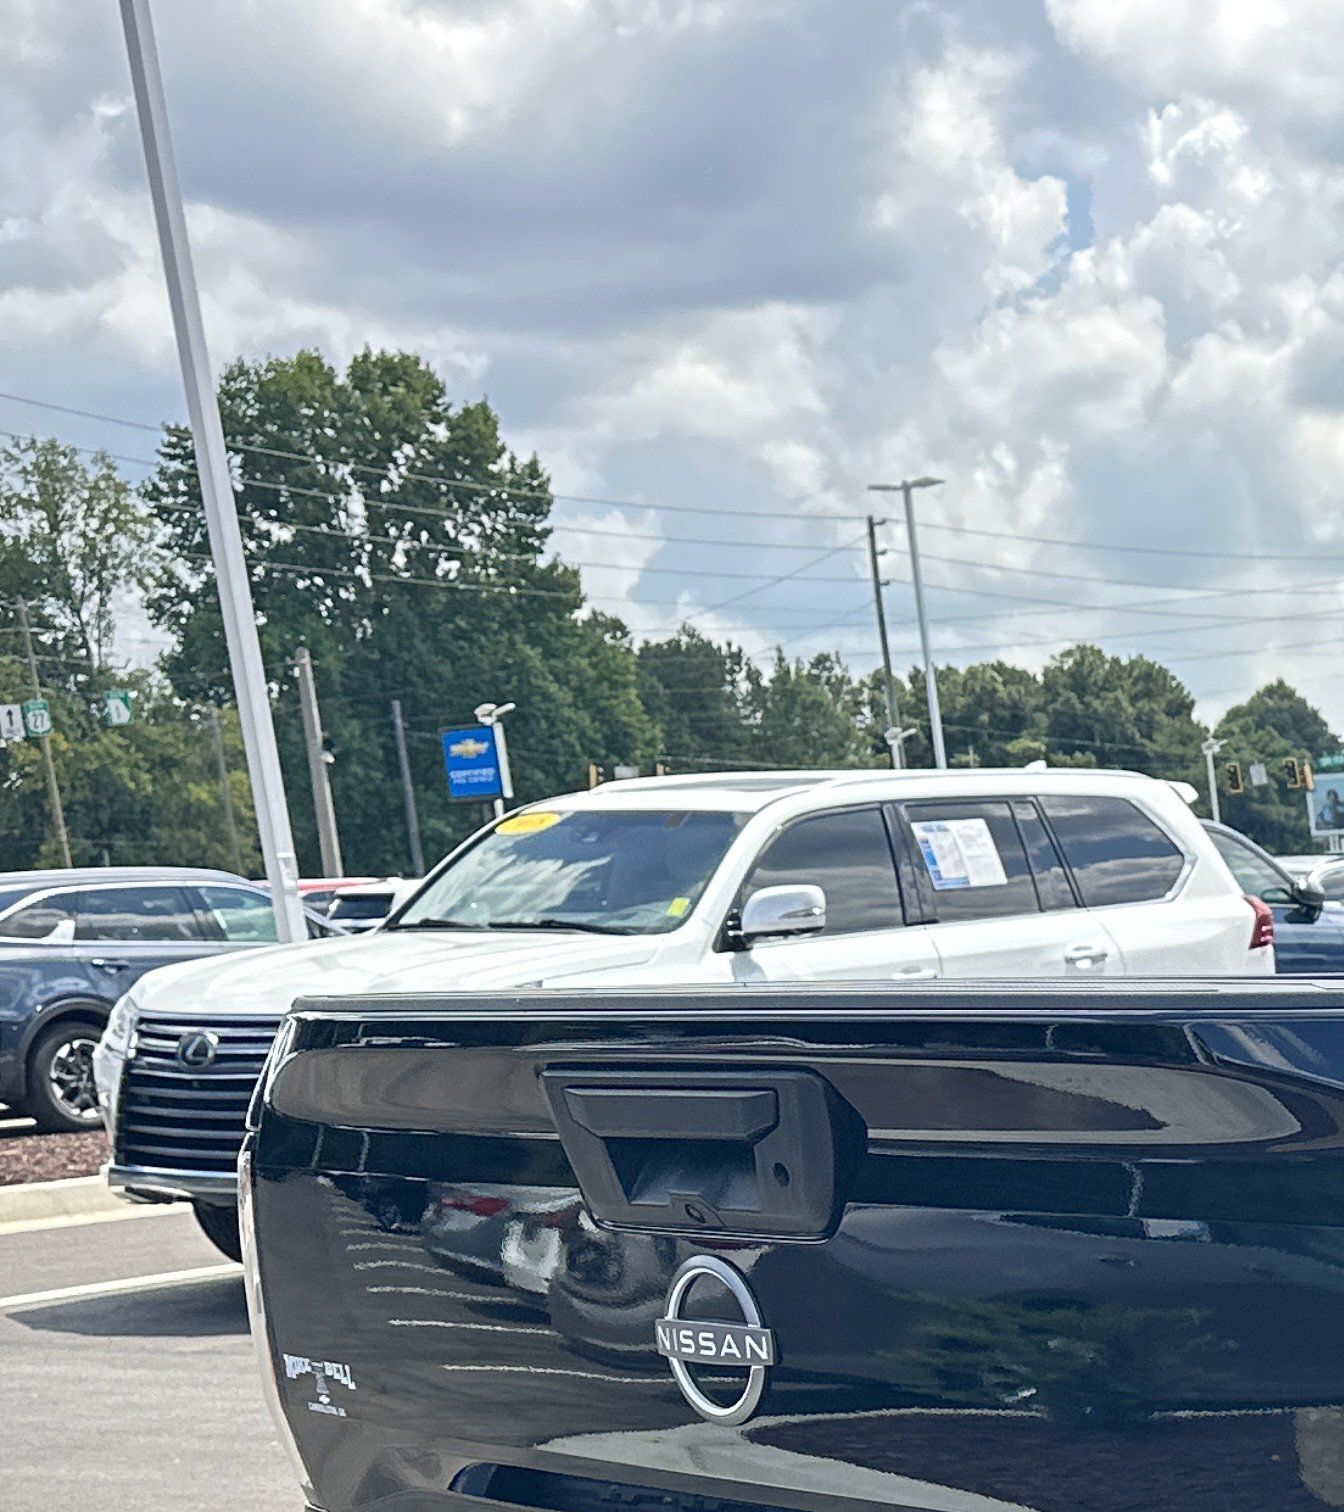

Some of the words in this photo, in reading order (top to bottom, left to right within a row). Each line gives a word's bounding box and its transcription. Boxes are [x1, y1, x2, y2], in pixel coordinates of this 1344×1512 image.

[32, 713, 45, 728] 27
[656, 1322, 769, 1361] NISSAN
[324, 1361, 357, 1390] BELL
